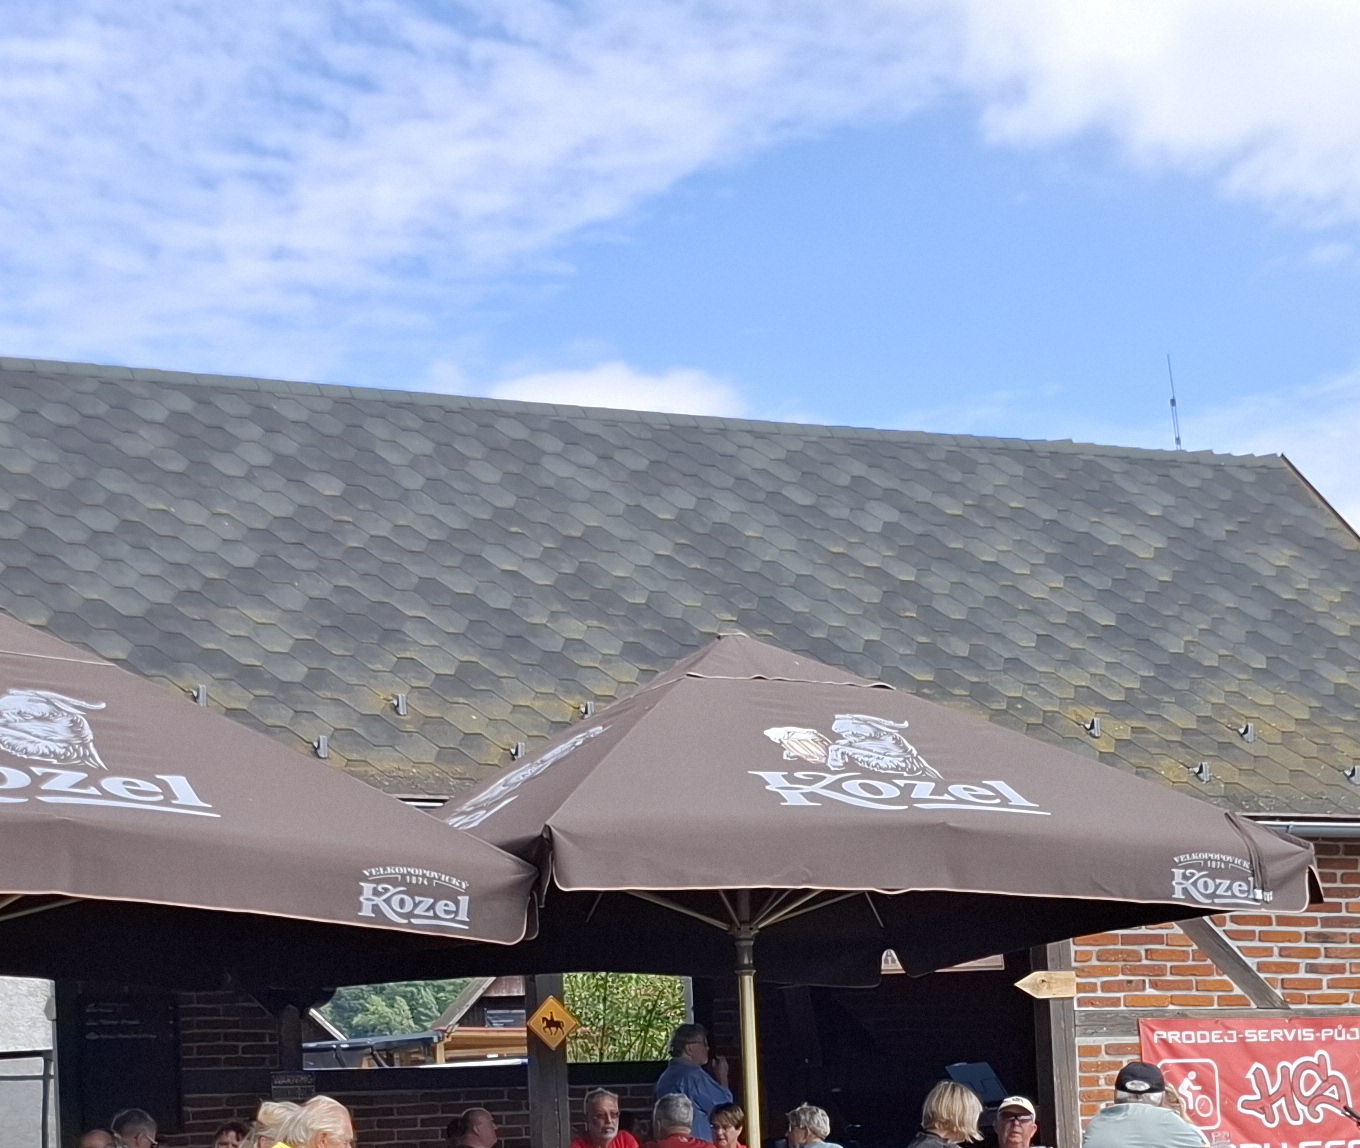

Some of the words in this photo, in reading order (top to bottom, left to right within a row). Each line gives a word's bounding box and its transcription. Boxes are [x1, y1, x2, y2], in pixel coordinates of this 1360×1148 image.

[748, 770, 1042, 810] Kozel
[1173, 852, 1252, 870] VELKOPOPOVICK
[357, 881, 470, 926] Kozel
[1171, 868, 1256, 904] Kozel
